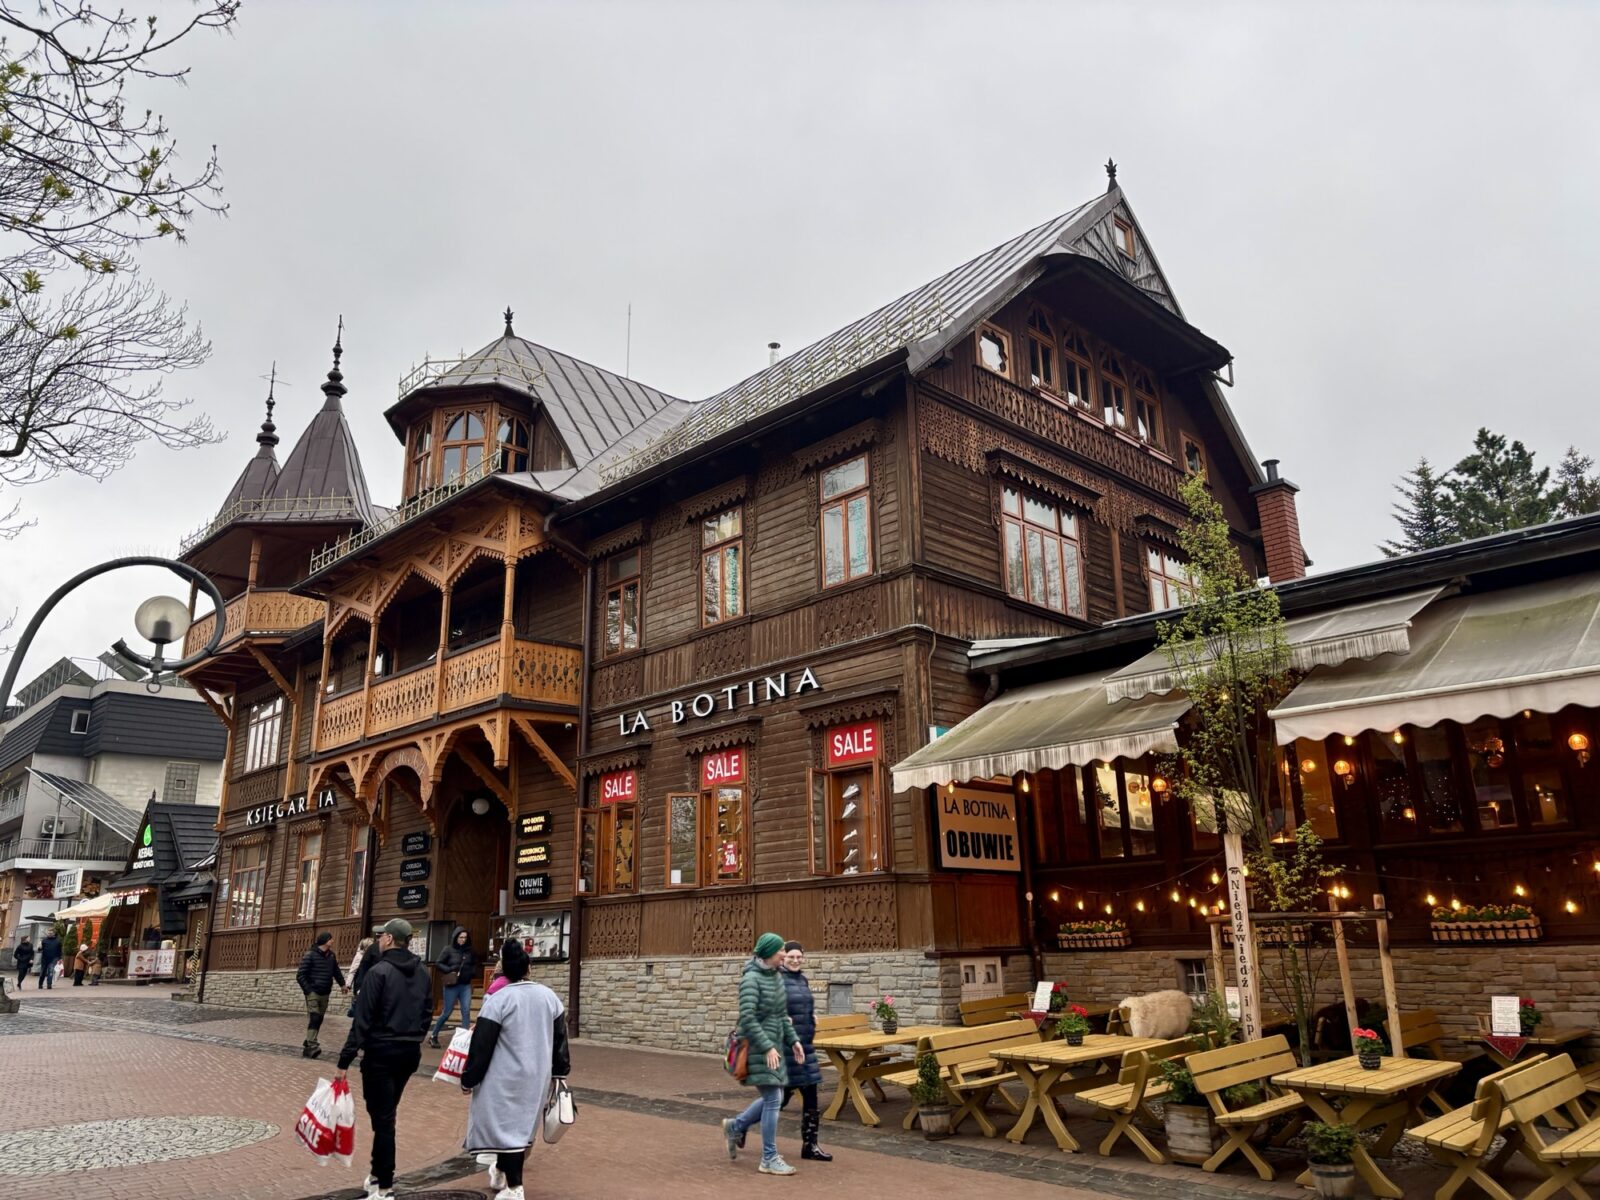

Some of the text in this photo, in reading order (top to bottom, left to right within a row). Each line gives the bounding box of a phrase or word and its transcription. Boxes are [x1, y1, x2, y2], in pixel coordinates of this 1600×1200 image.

[619, 667, 820, 736] LA BOTINA
[834, 728, 873, 757] SALE
[707, 754, 739, 780] SALE
[604, 775, 632, 798] SALE
[246, 790, 334, 827] KSIĘGARIA
[943, 796, 1010, 820] LA BOTINA
[946, 829, 1014, 861] OBUWIE
[56, 872, 78, 888] HOTEL
[519, 877, 543, 888] OBUWIE
[1230, 879, 1249, 988] Niedźwiedź
[441, 1053, 467, 1075] SAL
[298, 1113, 323, 1149] SALE
